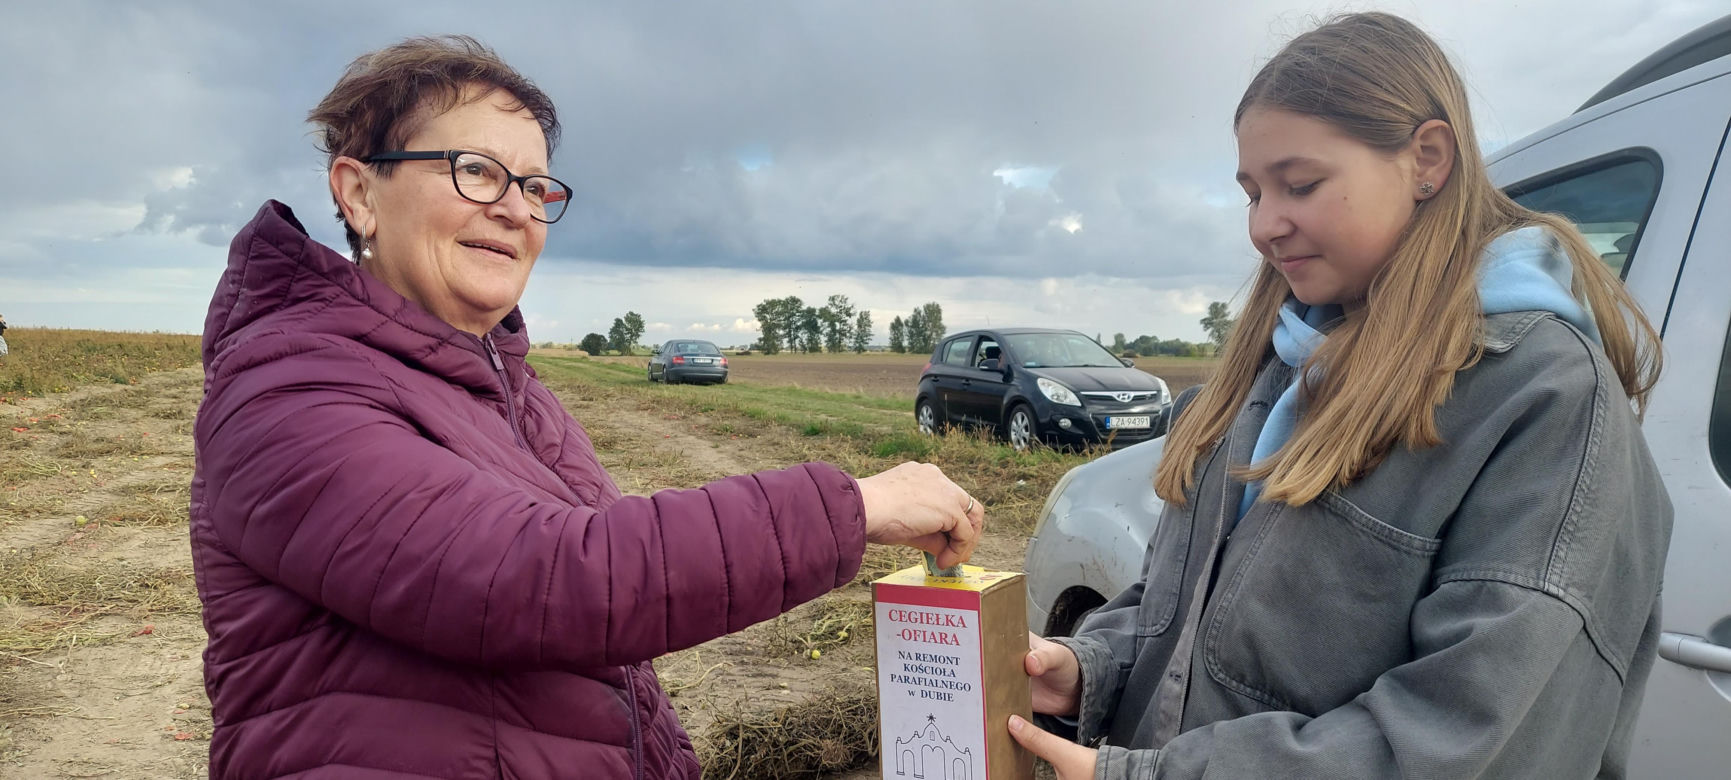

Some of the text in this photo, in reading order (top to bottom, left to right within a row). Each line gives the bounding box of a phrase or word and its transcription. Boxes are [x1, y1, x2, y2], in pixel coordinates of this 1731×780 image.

[1110, 417, 1149, 427] LZA 94391
[888, 609, 968, 629] CEGIEŁKA
[896, 628, 961, 647] -OFIARA
[898, 650, 961, 666] NA REMONT
[903, 663, 956, 678] KOŚCIOŁA
[890, 673, 971, 692] PARAFIALNEGO
[920, 689, 954, 702] DUBIE
